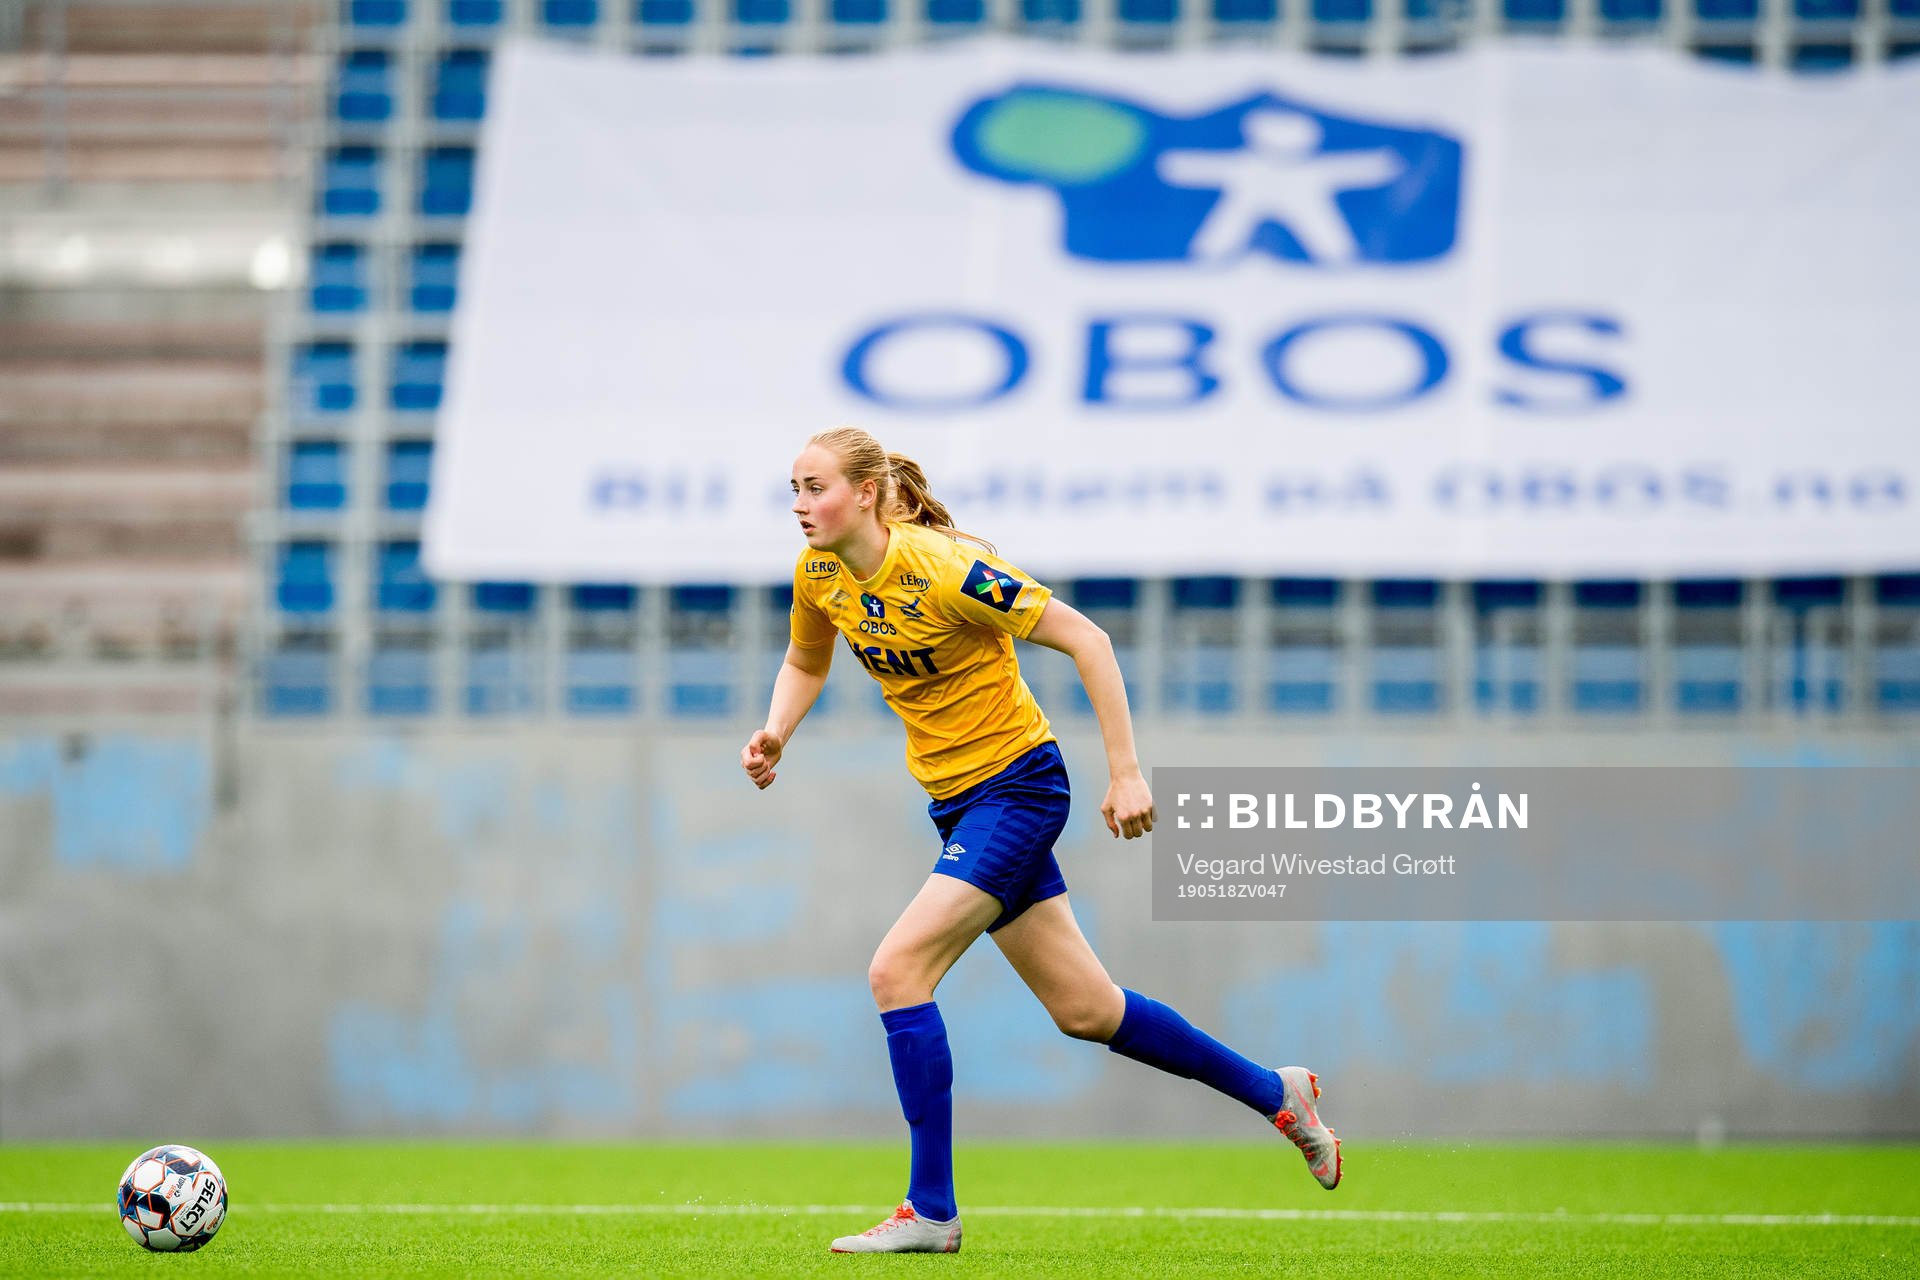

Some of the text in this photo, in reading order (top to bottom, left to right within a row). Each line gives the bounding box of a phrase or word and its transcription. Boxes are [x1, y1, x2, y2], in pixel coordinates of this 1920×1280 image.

[838, 312, 1628, 410] OBOS
[858, 620, 897, 635] OBOS
[180, 1178, 216, 1232] SELECT
